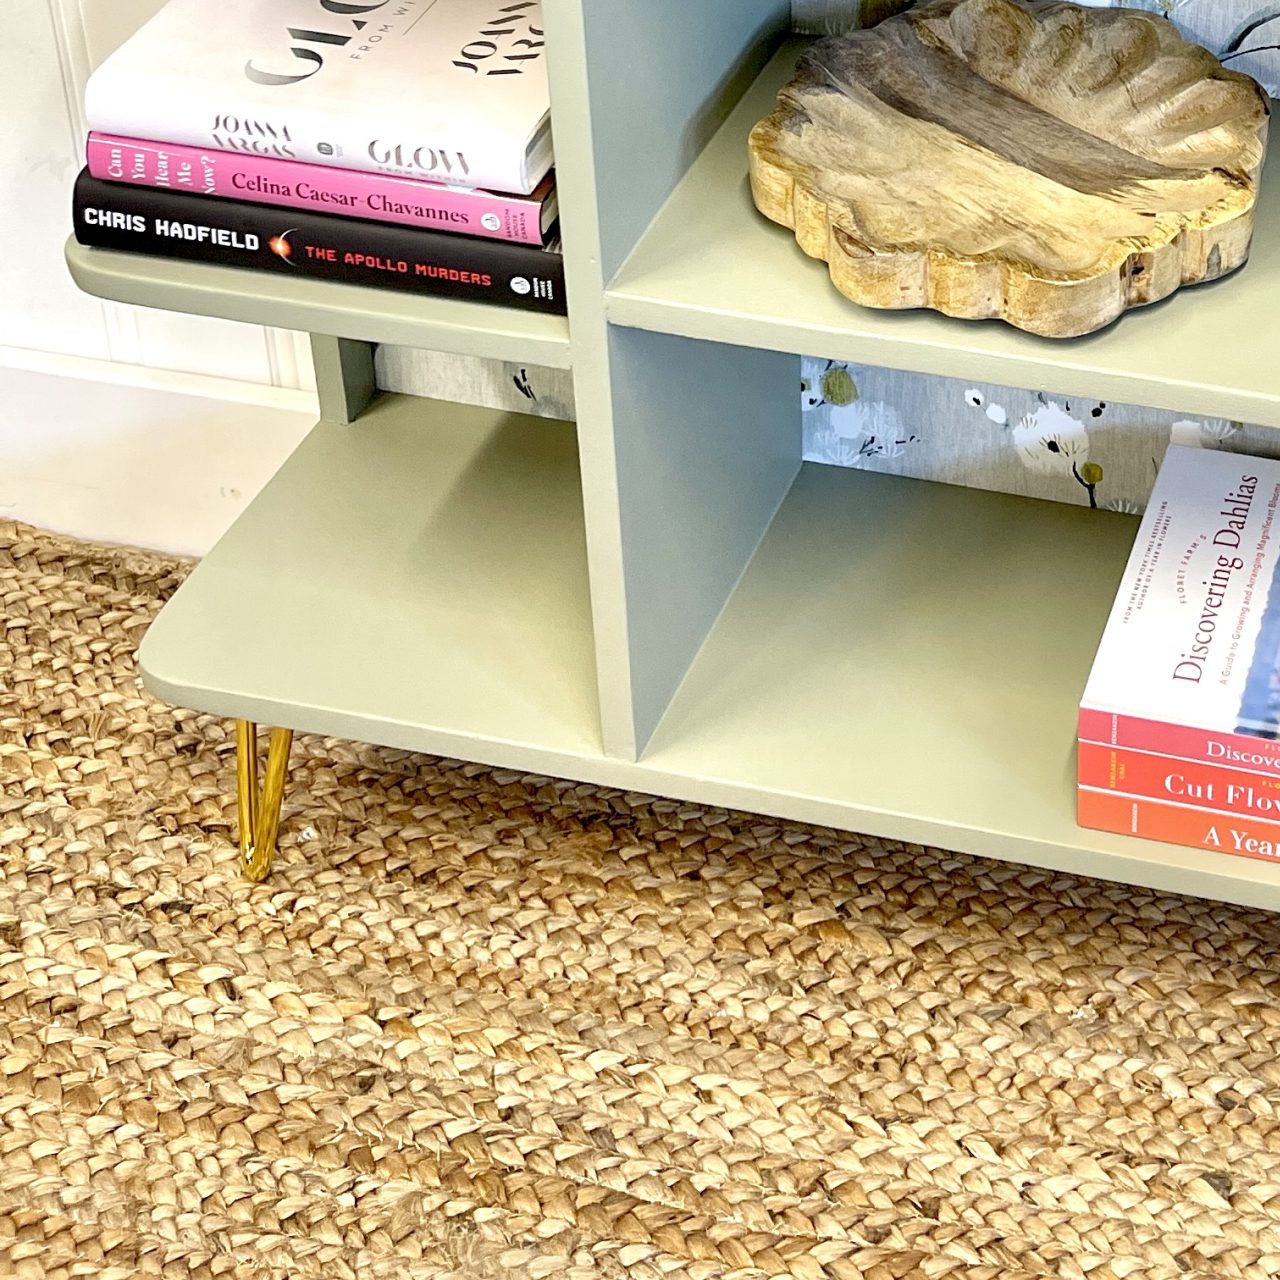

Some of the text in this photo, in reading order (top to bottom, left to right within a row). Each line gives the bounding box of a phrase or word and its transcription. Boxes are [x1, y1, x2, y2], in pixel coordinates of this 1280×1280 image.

[350, 24, 394, 60] FROM
[212, 114, 292, 141] JOANNA
[108, 148, 123, 177] Can
[211, 133, 296, 158] VARGAS
[367, 139, 470, 175] GLOW
[131, 153, 146, 179] You
[154, 151, 171, 187] Hear
[177, 162, 193, 186] Me
[201, 155, 217, 194] Now?
[231, 172, 470, 225] Celina Caesar-Chavannes
[84, 208, 260, 251] CHRIS HADFIELD
[304, 245, 492, 286] THE APOLLO MURDERS
[1256, 508, 1276, 551] Magnificent
[1173, 475, 1258, 684] Discovering Dahlias
[1177, 567, 1188, 605] FLORET
[1246, 551, 1265, 590] Arranging
[1243, 589, 1253, 605] and
[1232, 606, 1250, 640] Growing
[1230, 641, 1239, 651] to
[1222, 652, 1236, 677] Guide
[1164, 773, 1214, 801] Cut
[1202, 826, 1222, 847] A
